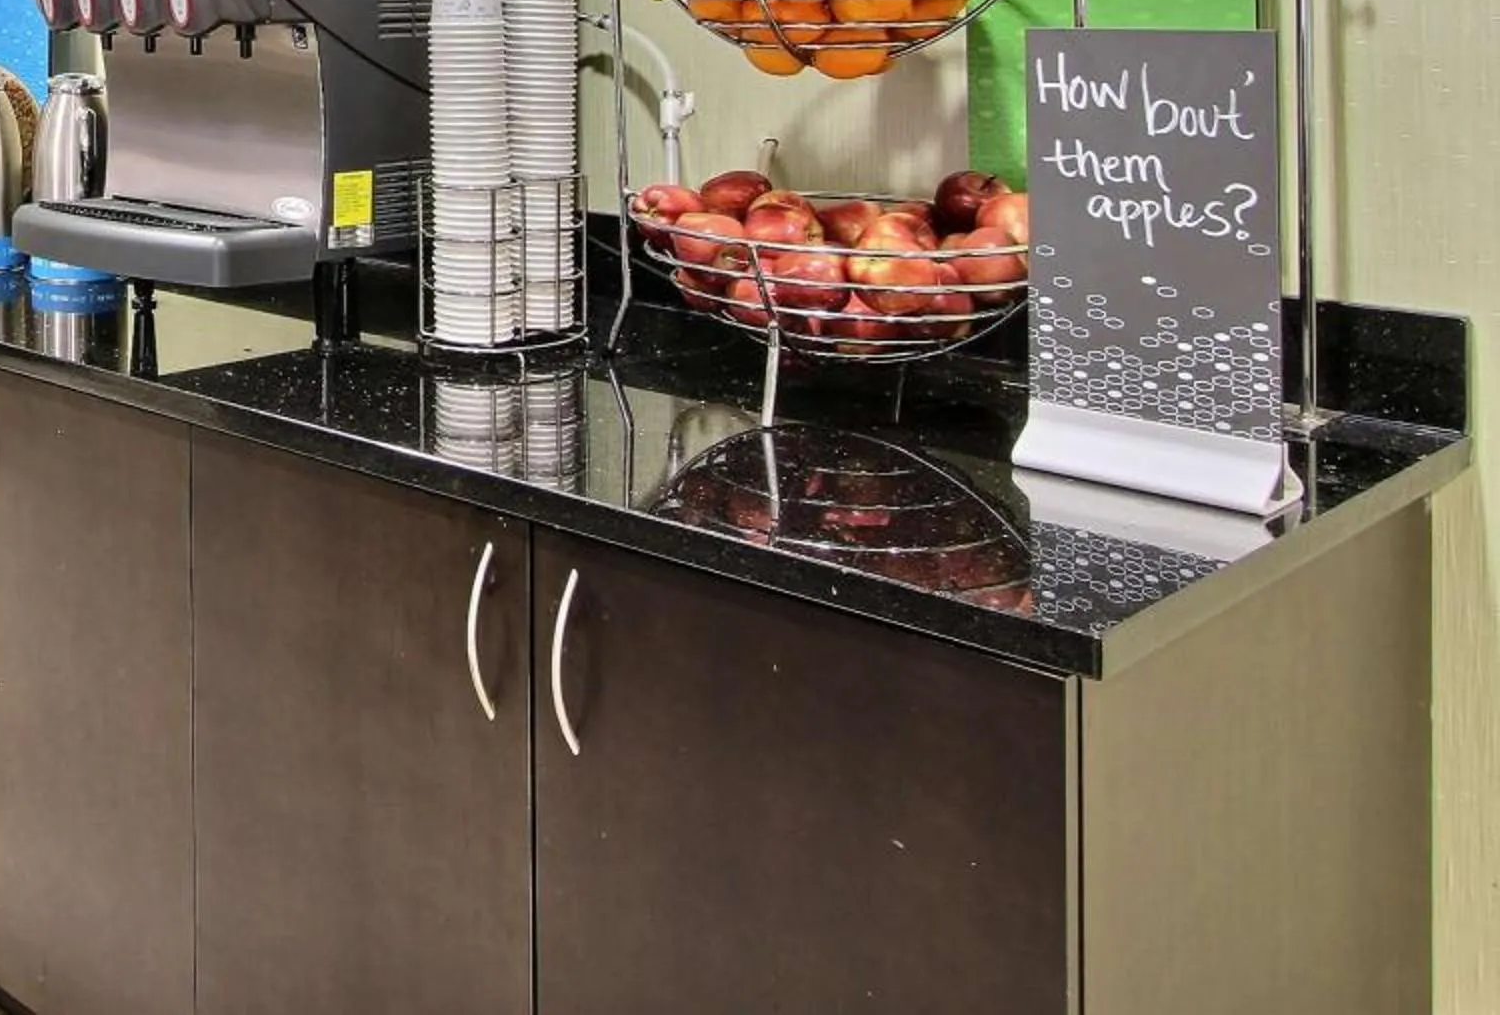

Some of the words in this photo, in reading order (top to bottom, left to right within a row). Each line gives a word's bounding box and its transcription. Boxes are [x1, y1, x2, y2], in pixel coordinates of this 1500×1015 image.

[1036, 52, 1129, 112] How
[1041, 139, 1171, 192] them
[1087, 183, 1258, 247] apples?
